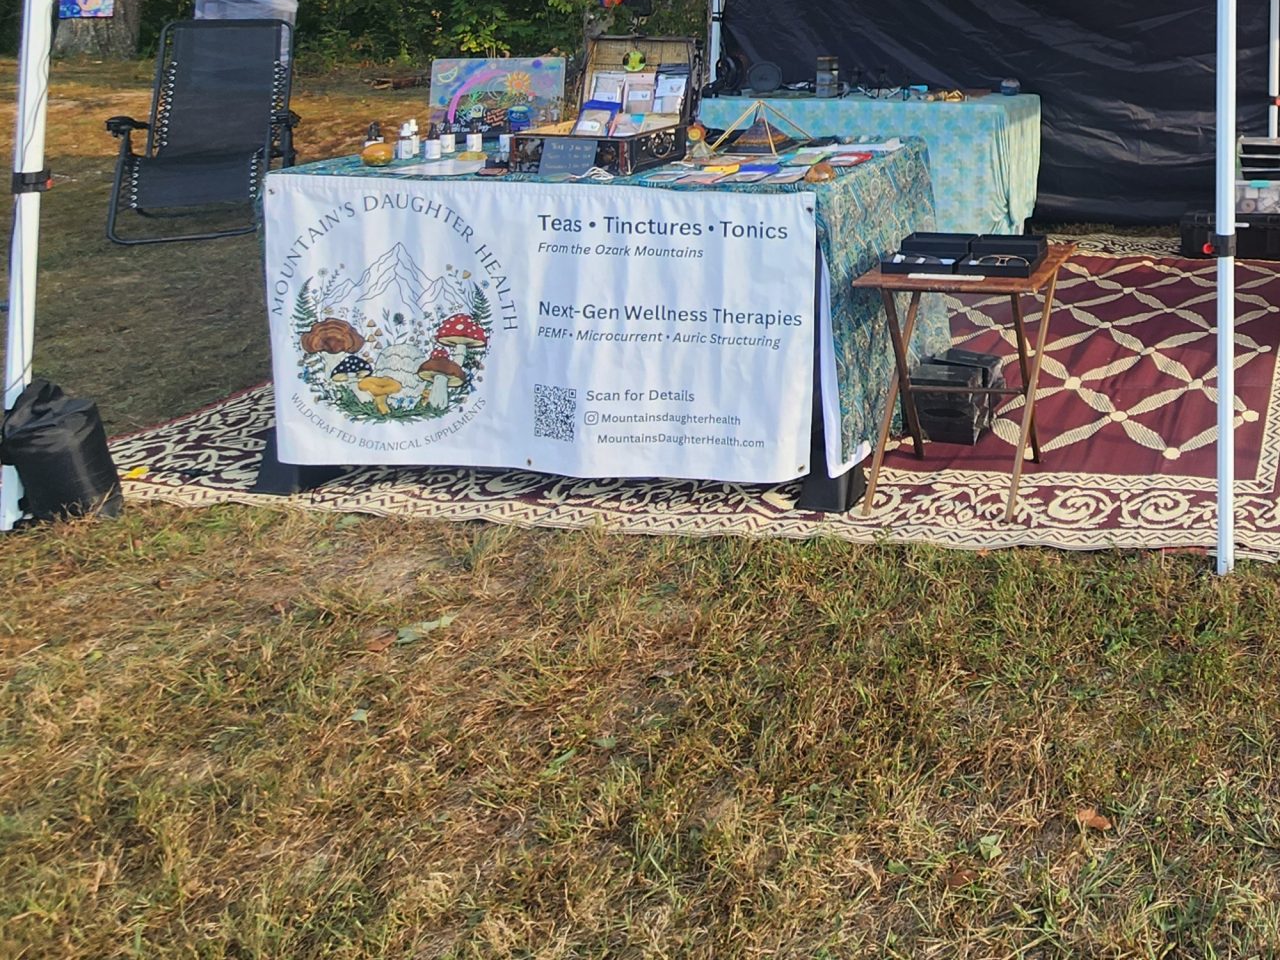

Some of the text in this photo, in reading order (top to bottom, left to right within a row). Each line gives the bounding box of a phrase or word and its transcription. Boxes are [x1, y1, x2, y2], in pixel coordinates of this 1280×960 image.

[537, 214, 788, 240] Teas Tinctures Tonics
[272, 193, 519, 331] MOUNTAIN'S DAUGHTER HEALTH
[538, 242, 704, 258] From the Ozark Mountains
[538, 301, 803, 329] Next-Gen Wellness Therapies
[537, 326, 781, 350] PEMF Microcurrent Auric Structuring
[585, 389, 695, 402] Scan for Details
[290, 392, 487, 452] WILDCRAFTED BOTANICAL SUPPLEMENTS
[601, 412, 741, 426] Mountainsdaughterhealth
[597, 433, 765, 449] MountainsDaughterHealth.com
